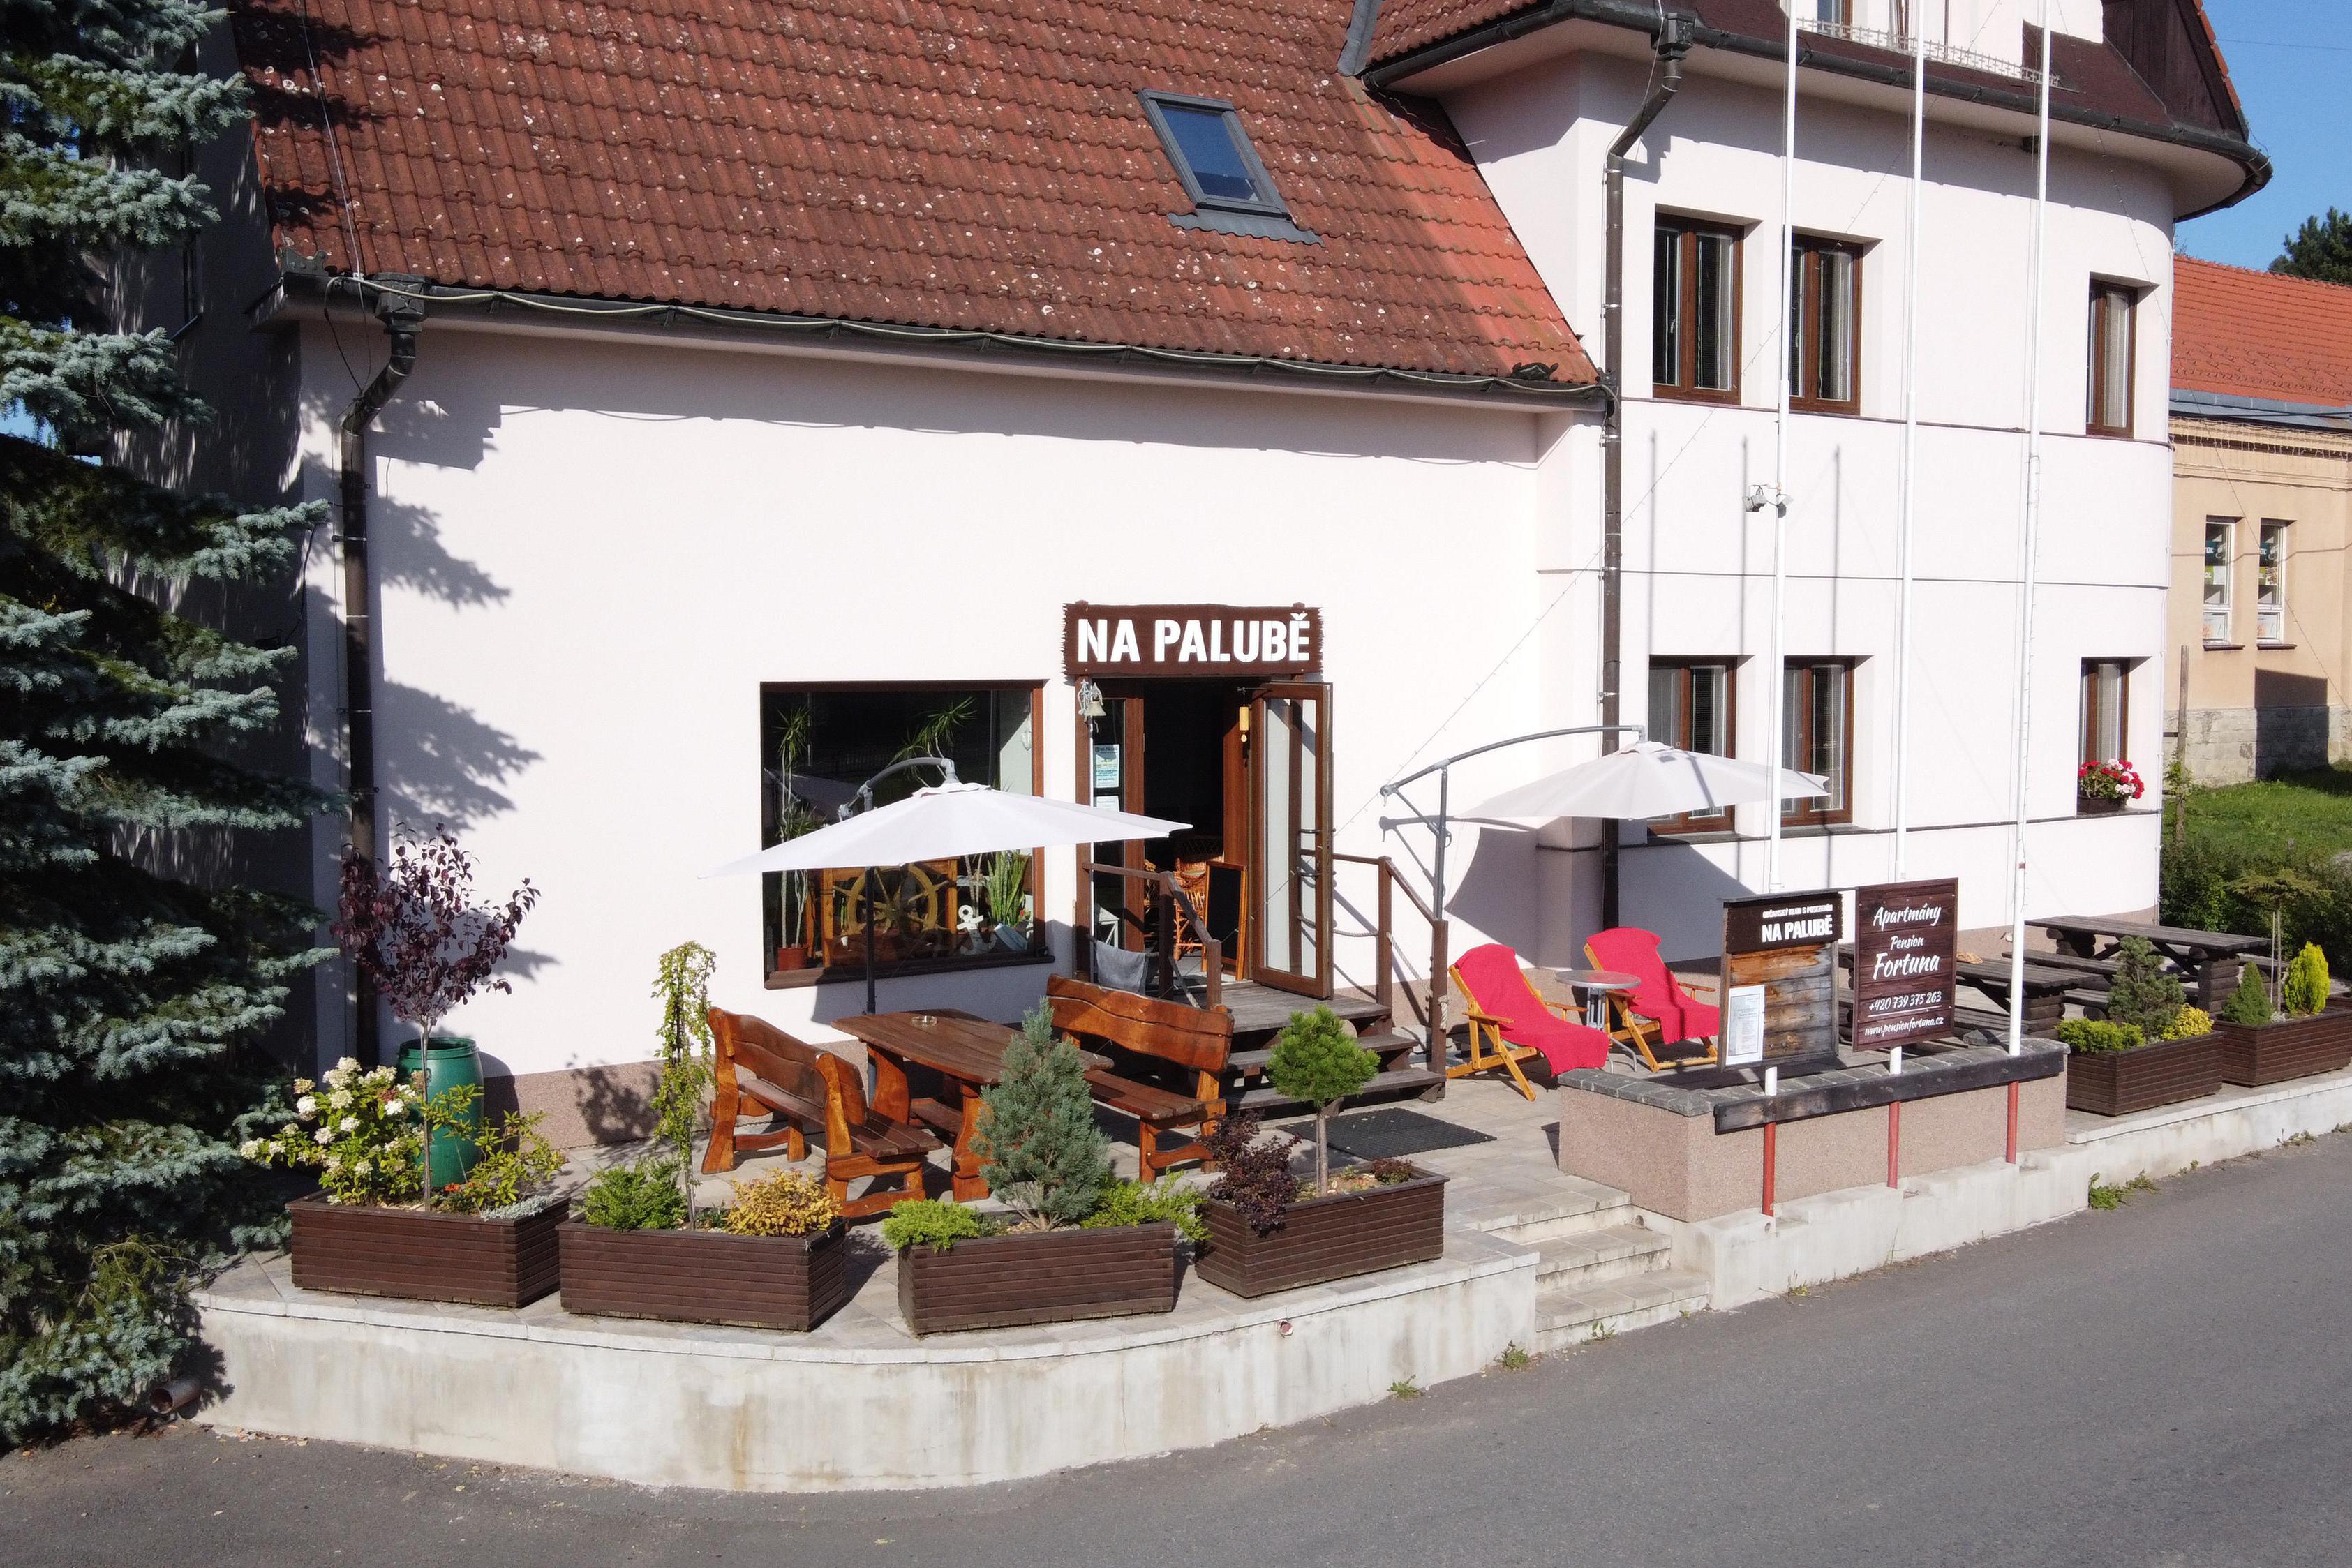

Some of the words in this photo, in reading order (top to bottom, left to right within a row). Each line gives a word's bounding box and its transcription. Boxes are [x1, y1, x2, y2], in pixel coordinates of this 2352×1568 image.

[1078, 618, 1141, 662] NA
[1154, 613, 1310, 662] PALUBĚ
[1762, 923, 1782, 943] NA
[1785, 914, 1833, 940] PALUBĚ
[1873, 902, 1942, 932] Apartmány
[1890, 934, 1925, 950] Pension
[1873, 952, 1940, 980] Fortuna
[1868, 997, 1892, 1011] +420
[1893, 995, 1909, 1009] 739
[1909, 993, 1926, 1006] 375
[1926, 991, 1942, 1004] 263
[1864, 1017, 1944, 1037] www.pensionfortuna.cz
